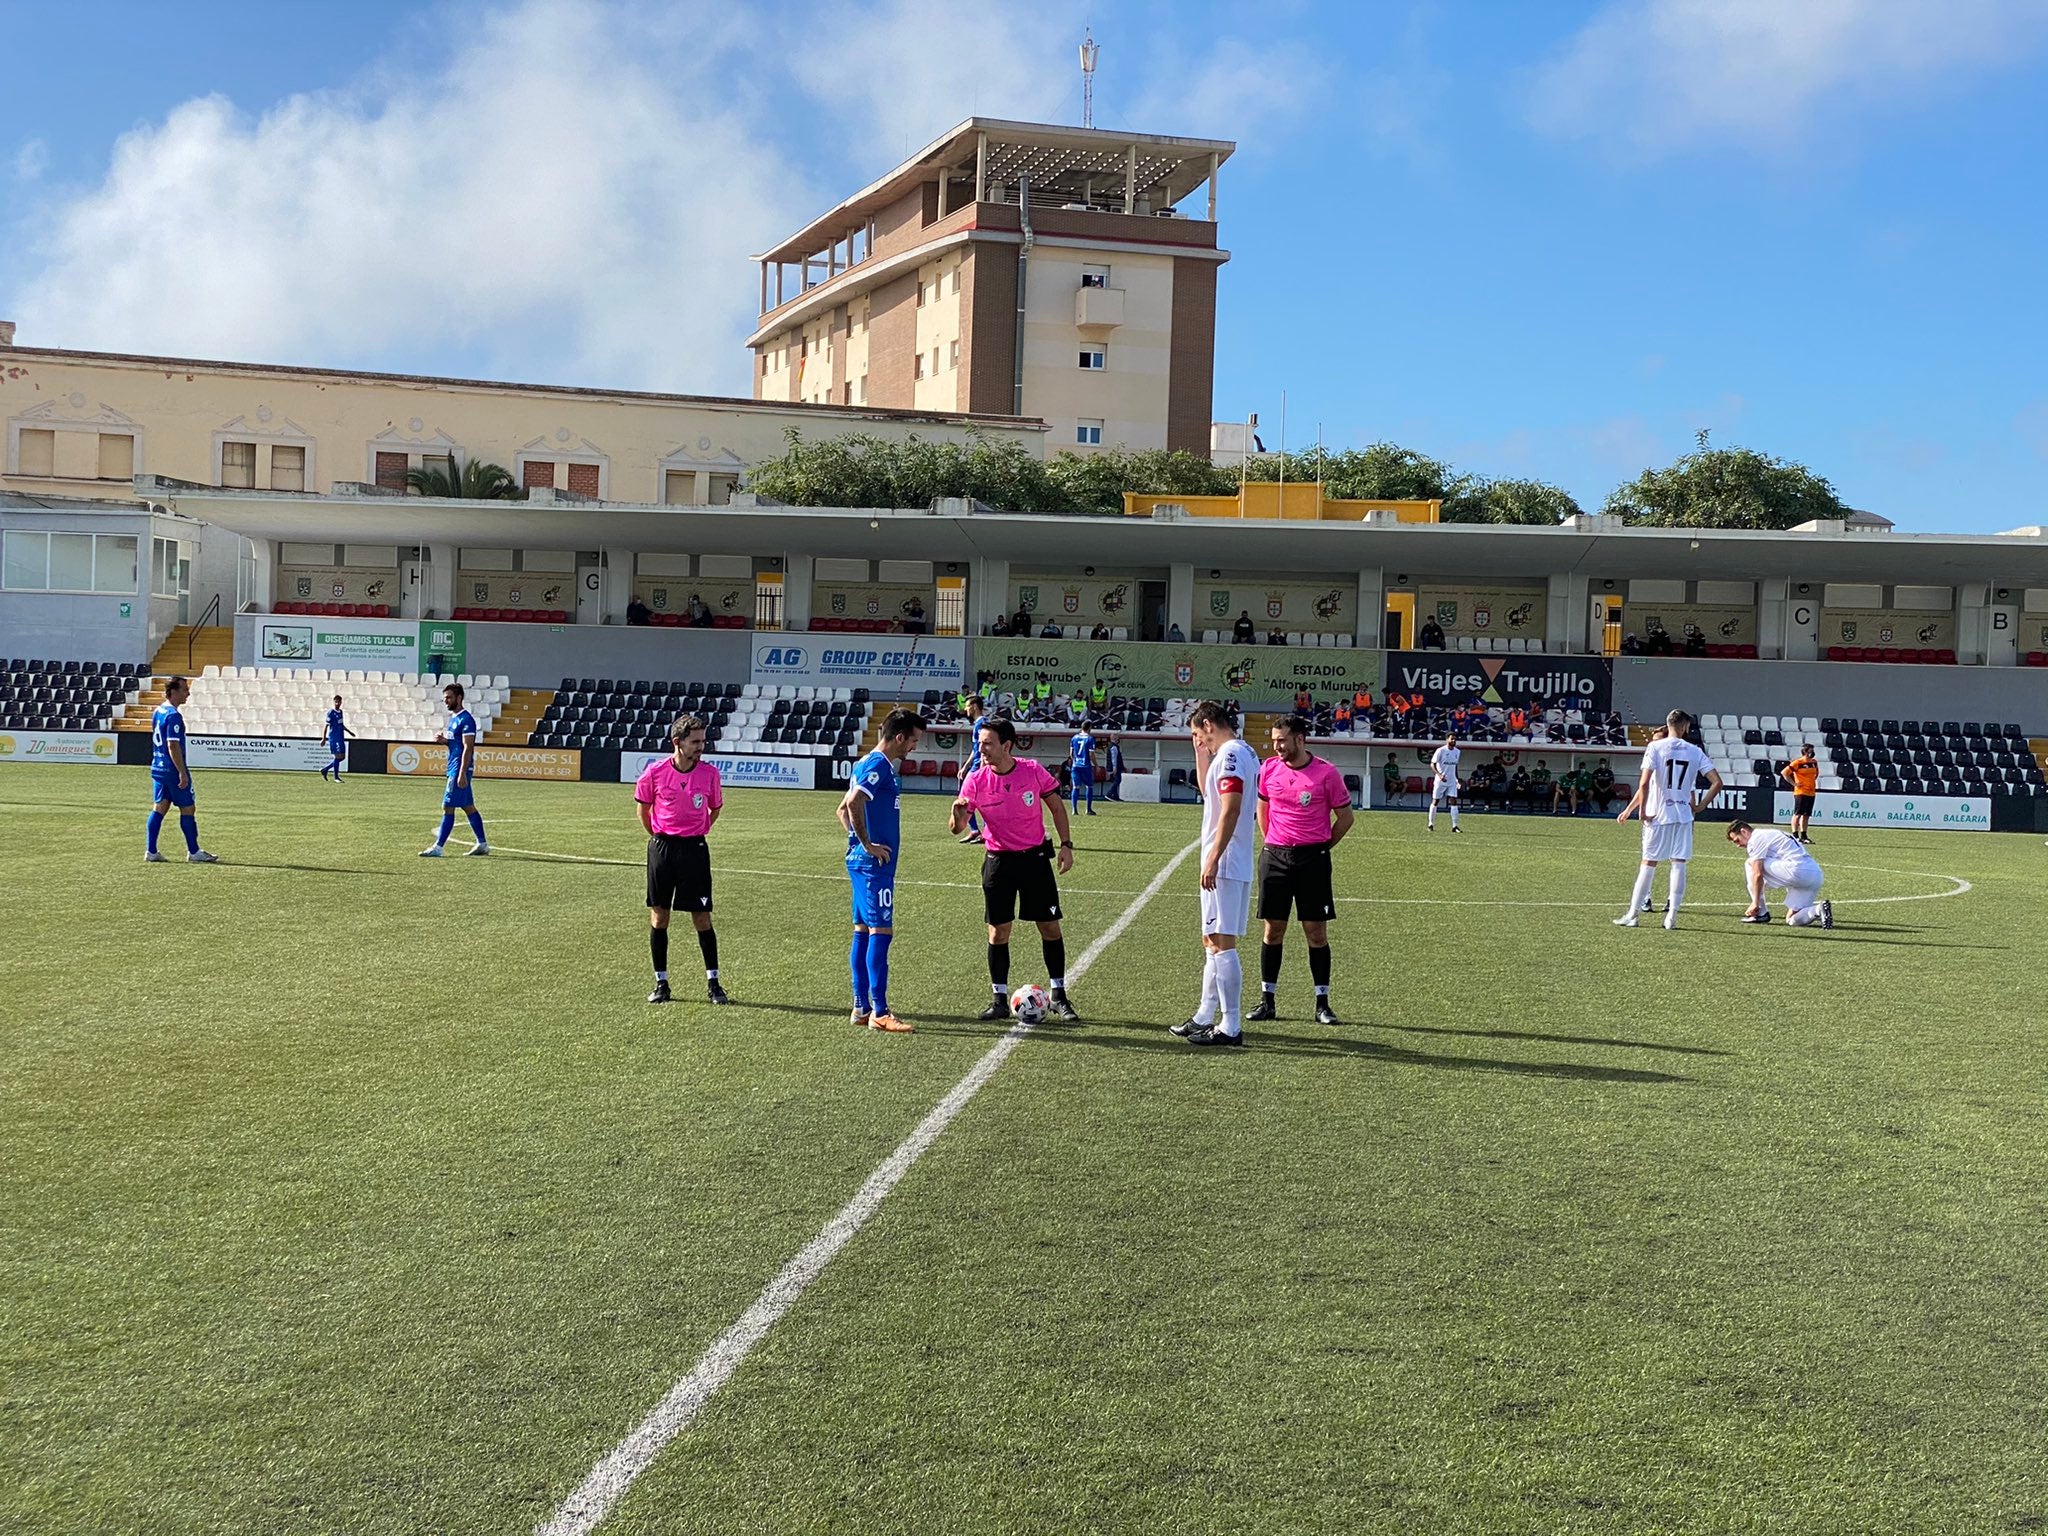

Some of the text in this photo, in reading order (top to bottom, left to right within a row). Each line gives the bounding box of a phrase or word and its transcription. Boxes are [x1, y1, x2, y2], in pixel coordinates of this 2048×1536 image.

[586, 573, 600, 591] G
[1594, 603, 1601, 619] D
[1795, 608, 1811, 625] C
[1993, 612, 2008, 630] B
[372, 636, 383, 645] TU
[385, 636, 406, 646] CASA
[433, 631, 452, 644] MC
[764, 648, 801, 666] AG
[821, 649, 878, 665] GROUP
[881, 652, 936, 667] CEUTA
[1007, 655, 1059, 667] ESTADIO
[819, 667, 871, 675] CONSTRUCCIONES
[1293, 665, 1346, 677] ESTADIO
[1402, 667, 1595, 699] Viajes Trujillo
[1553, 697, 1592, 709] .cm
[190, 739, 220, 747] CAPOTE
[1077, 740, 1085, 756] 7
[560, 754, 577, 765] S.L.
[477, 765, 512, 775] NUESTRA
[513, 766, 542, 776] RAZÓN
[543, 768, 555, 776] DE
[556, 768, 571, 777] SER
[736, 761, 780, 774] CEUTA
[1665, 758, 1690, 791] 17
[1833, 810, 1877, 820] BALEARIA
[1887, 812, 1931, 822] BALEARIA
[1943, 814, 1987, 824] BALEARIA
[878, 888, 892, 907] 10
